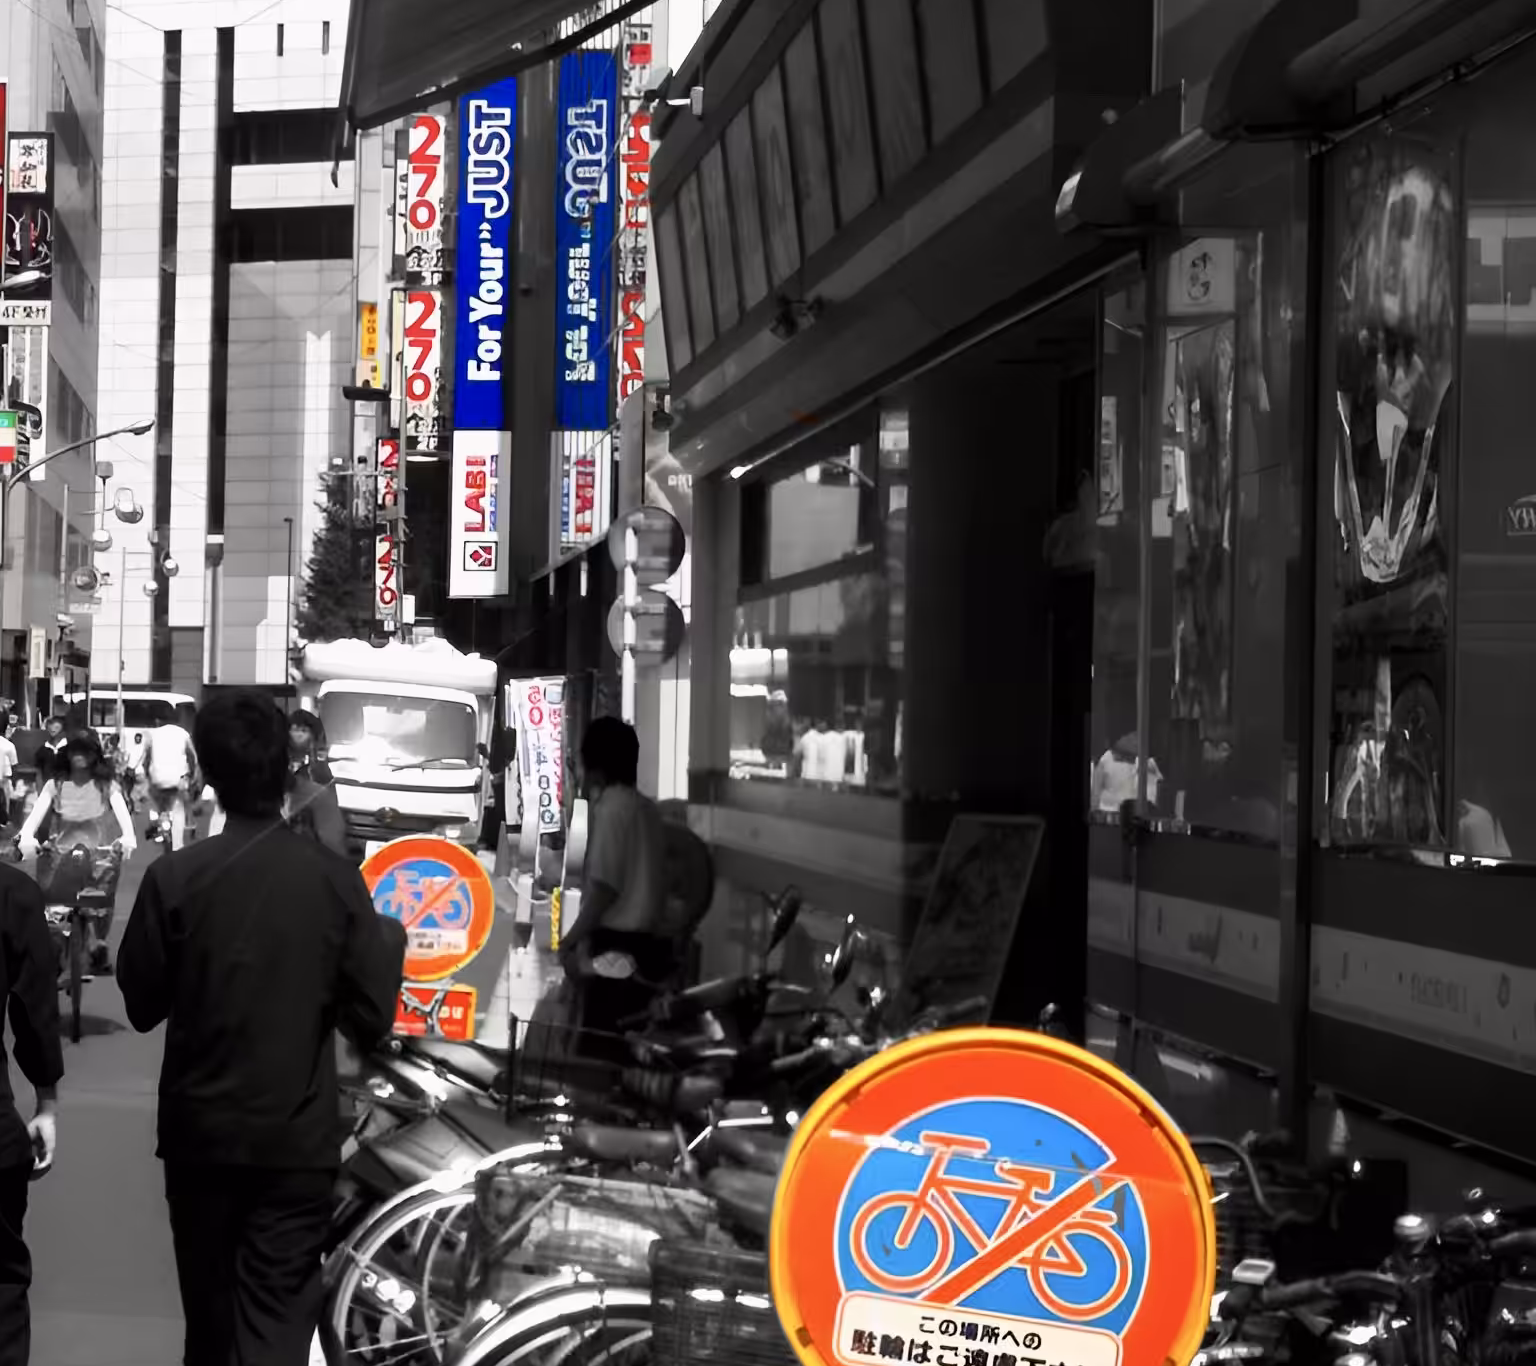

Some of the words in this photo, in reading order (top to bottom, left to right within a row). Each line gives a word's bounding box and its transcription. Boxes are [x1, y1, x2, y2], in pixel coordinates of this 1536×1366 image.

[408, 115, 441, 230] 270
[467, 99, 511, 219] JUST
[469, 242, 505, 323] Your
[405, 291, 436, 401] 270
[467, 325, 502, 381] For
[464, 455, 487, 533] LABI
[918, 1316, 1042, 1350] この場所への
